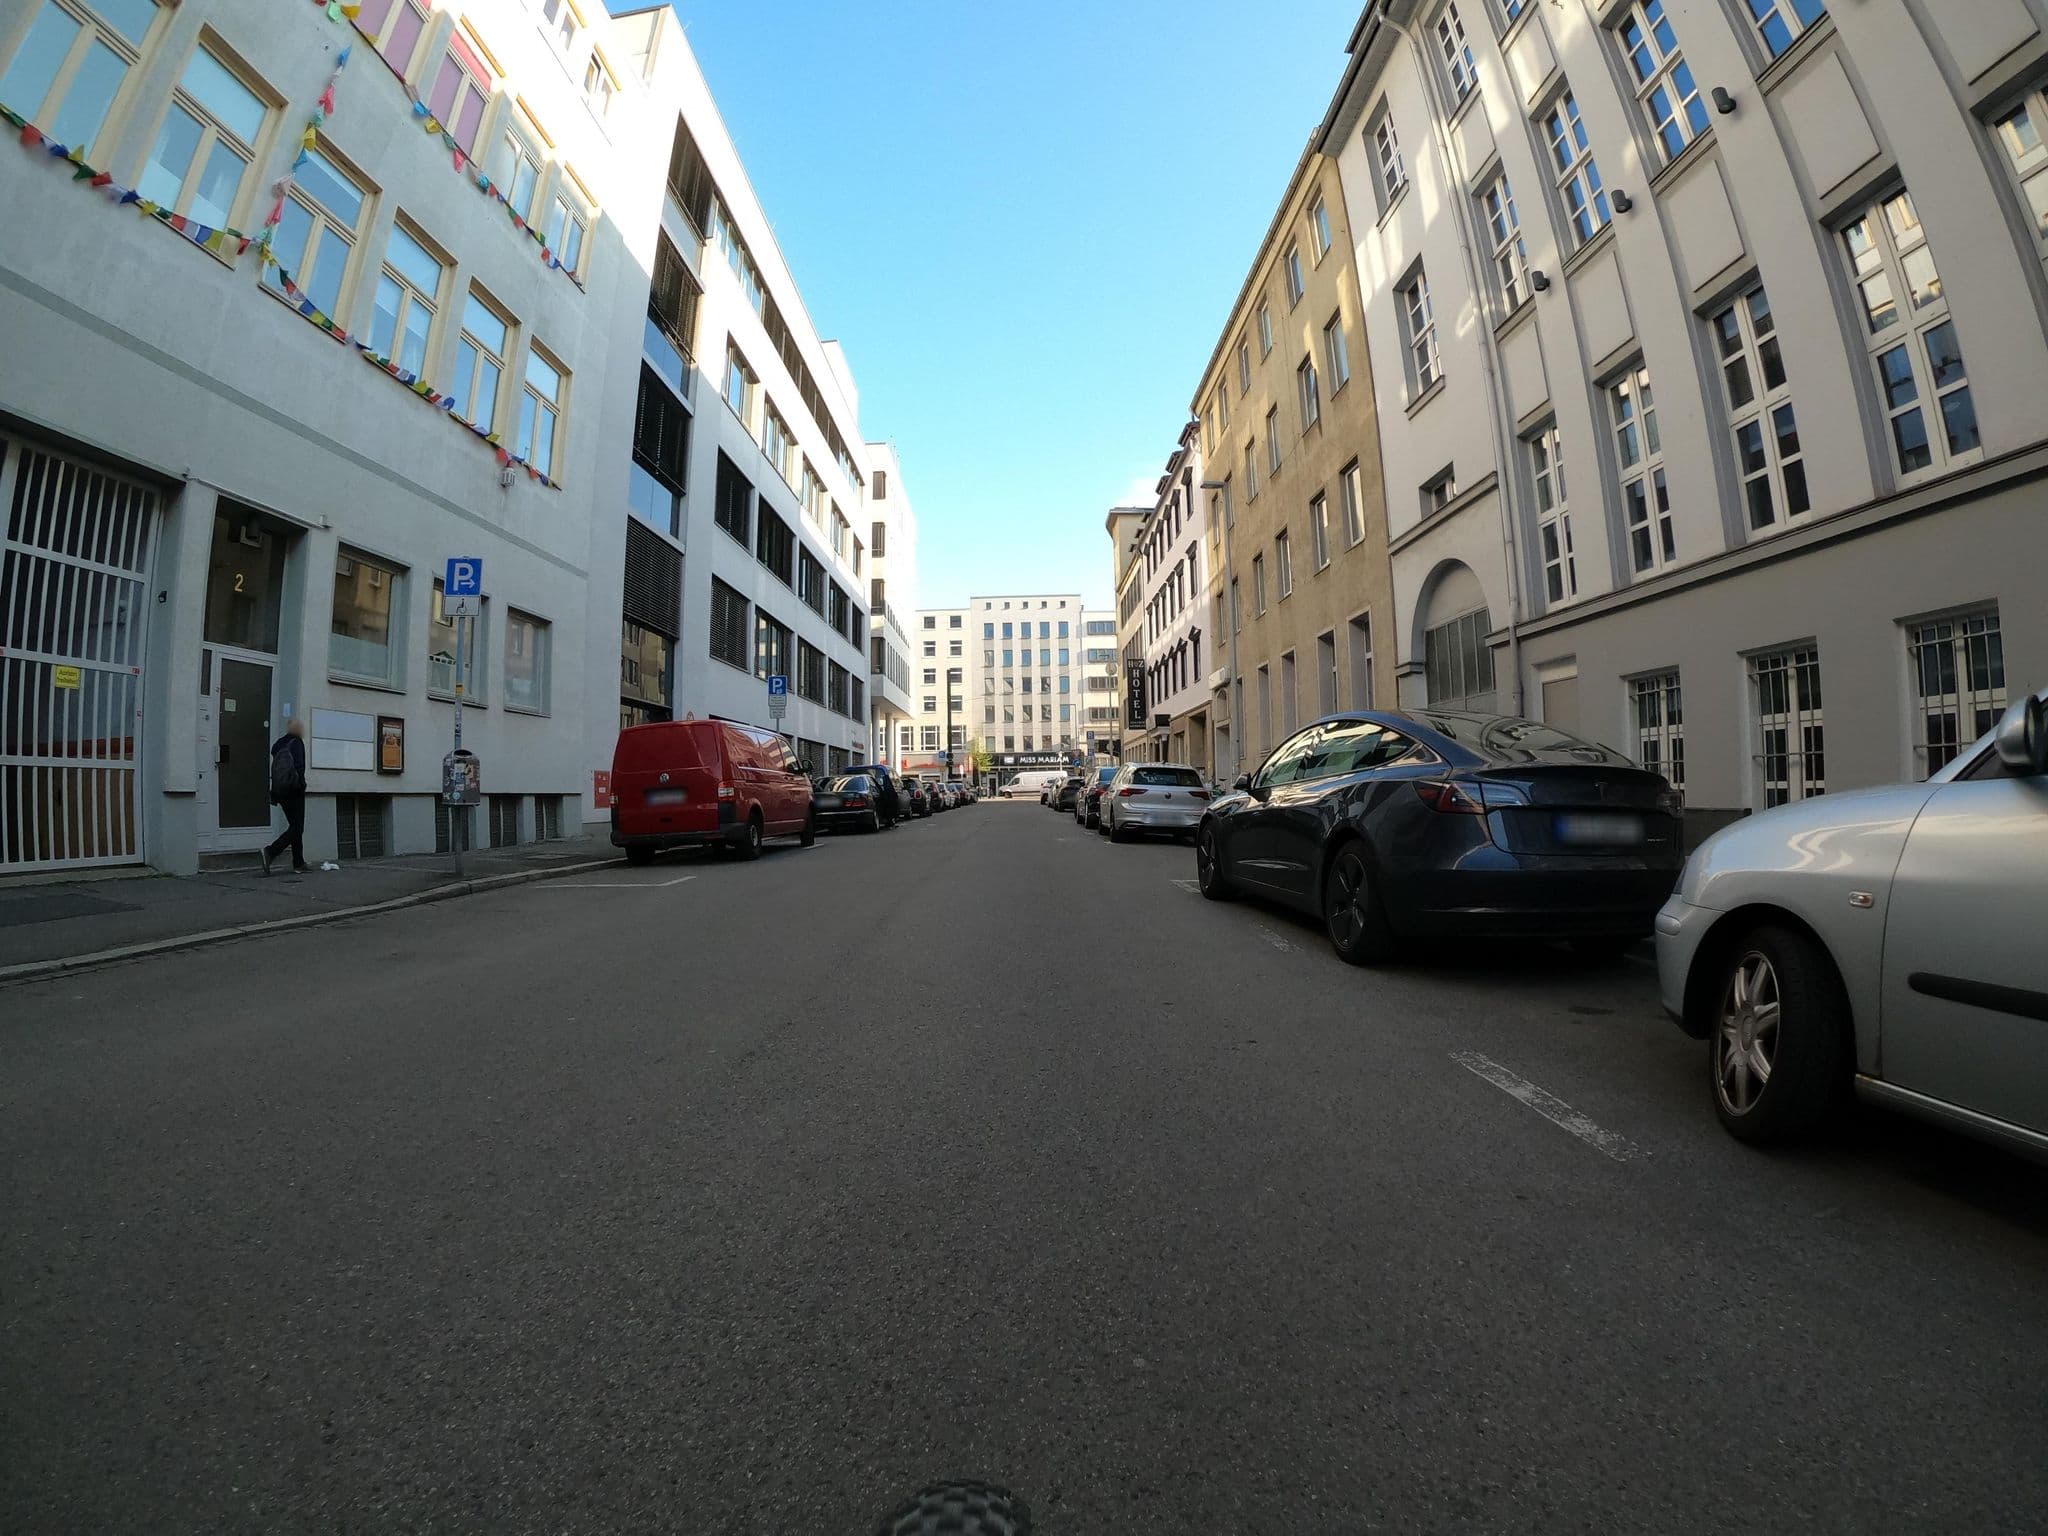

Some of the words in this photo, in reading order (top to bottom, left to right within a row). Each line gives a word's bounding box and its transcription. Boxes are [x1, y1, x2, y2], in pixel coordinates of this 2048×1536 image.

[234, 573, 244, 592] 2
[453, 563, 474, 591] P
[772, 678, 783, 693] P
[1132, 669, 1141, 718] HOTEL
